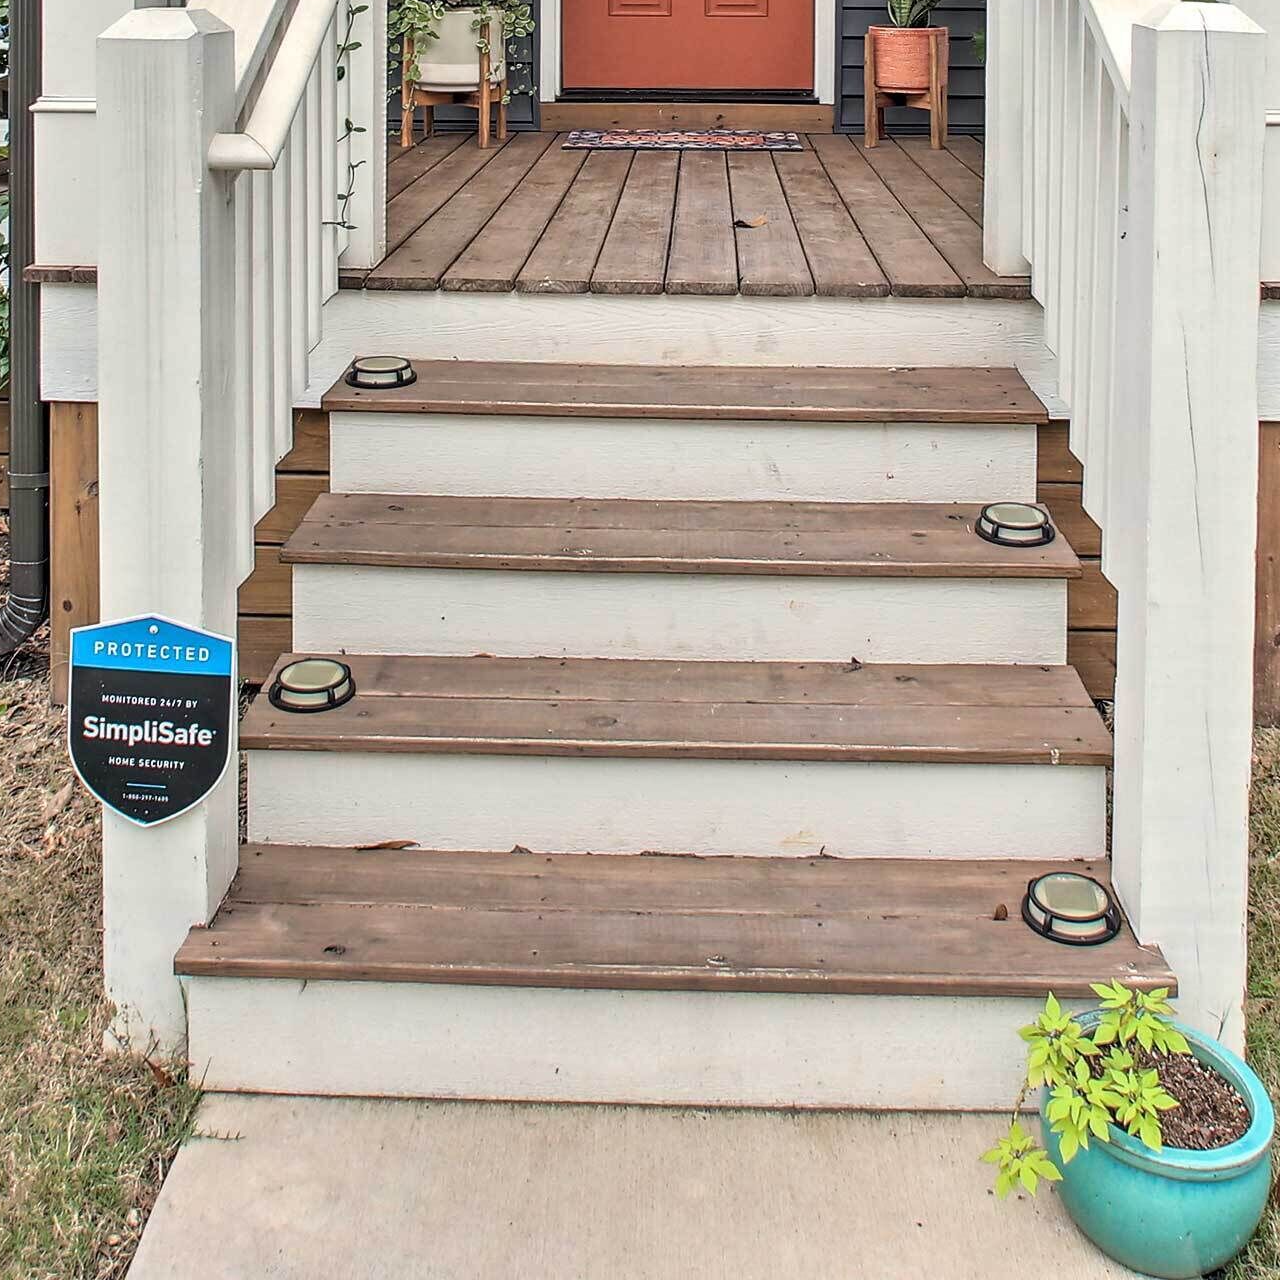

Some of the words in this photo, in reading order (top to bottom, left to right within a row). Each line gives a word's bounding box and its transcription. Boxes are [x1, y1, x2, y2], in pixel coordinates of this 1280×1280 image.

[94, 641, 210, 662] PROTECTED
[101, 694, 157, 706] MONITORED
[160, 698, 182, 708] 24/7
[185, 700, 198, 709] BY
[83, 715, 213, 747] SimpliSafe
[108, 756, 135, 767] HOME
[138, 758, 185, 769] SECURITY
